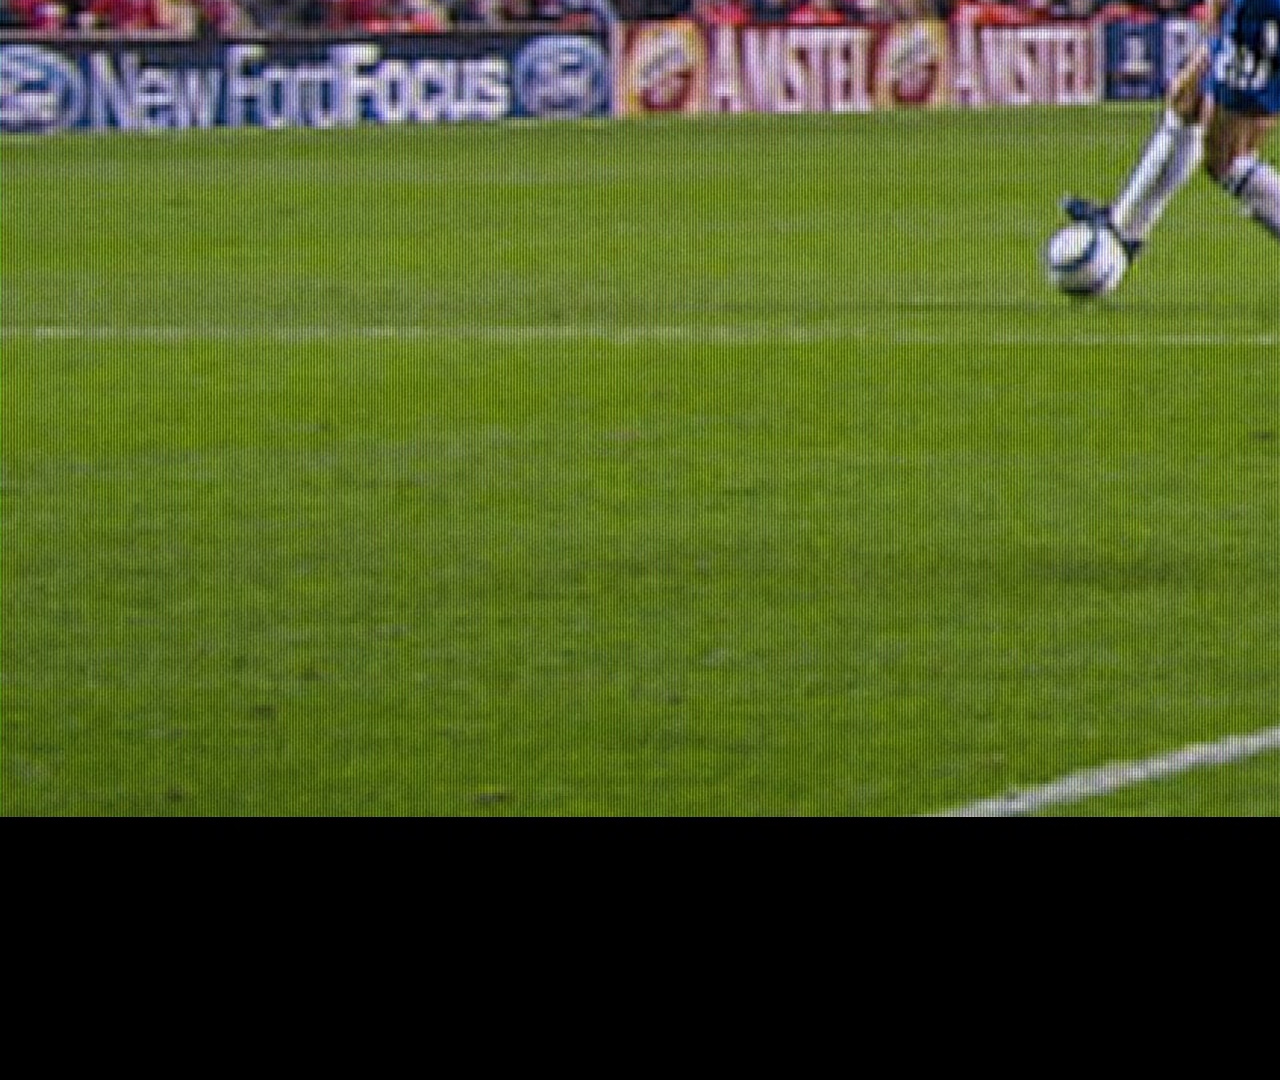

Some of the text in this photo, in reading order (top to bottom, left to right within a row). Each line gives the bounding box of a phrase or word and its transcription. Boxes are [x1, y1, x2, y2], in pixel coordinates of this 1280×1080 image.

[91, 48, 219, 132] New
[710, 23, 872, 113] AMSTEL
[953, 20, 1097, 106] AMSTEL
